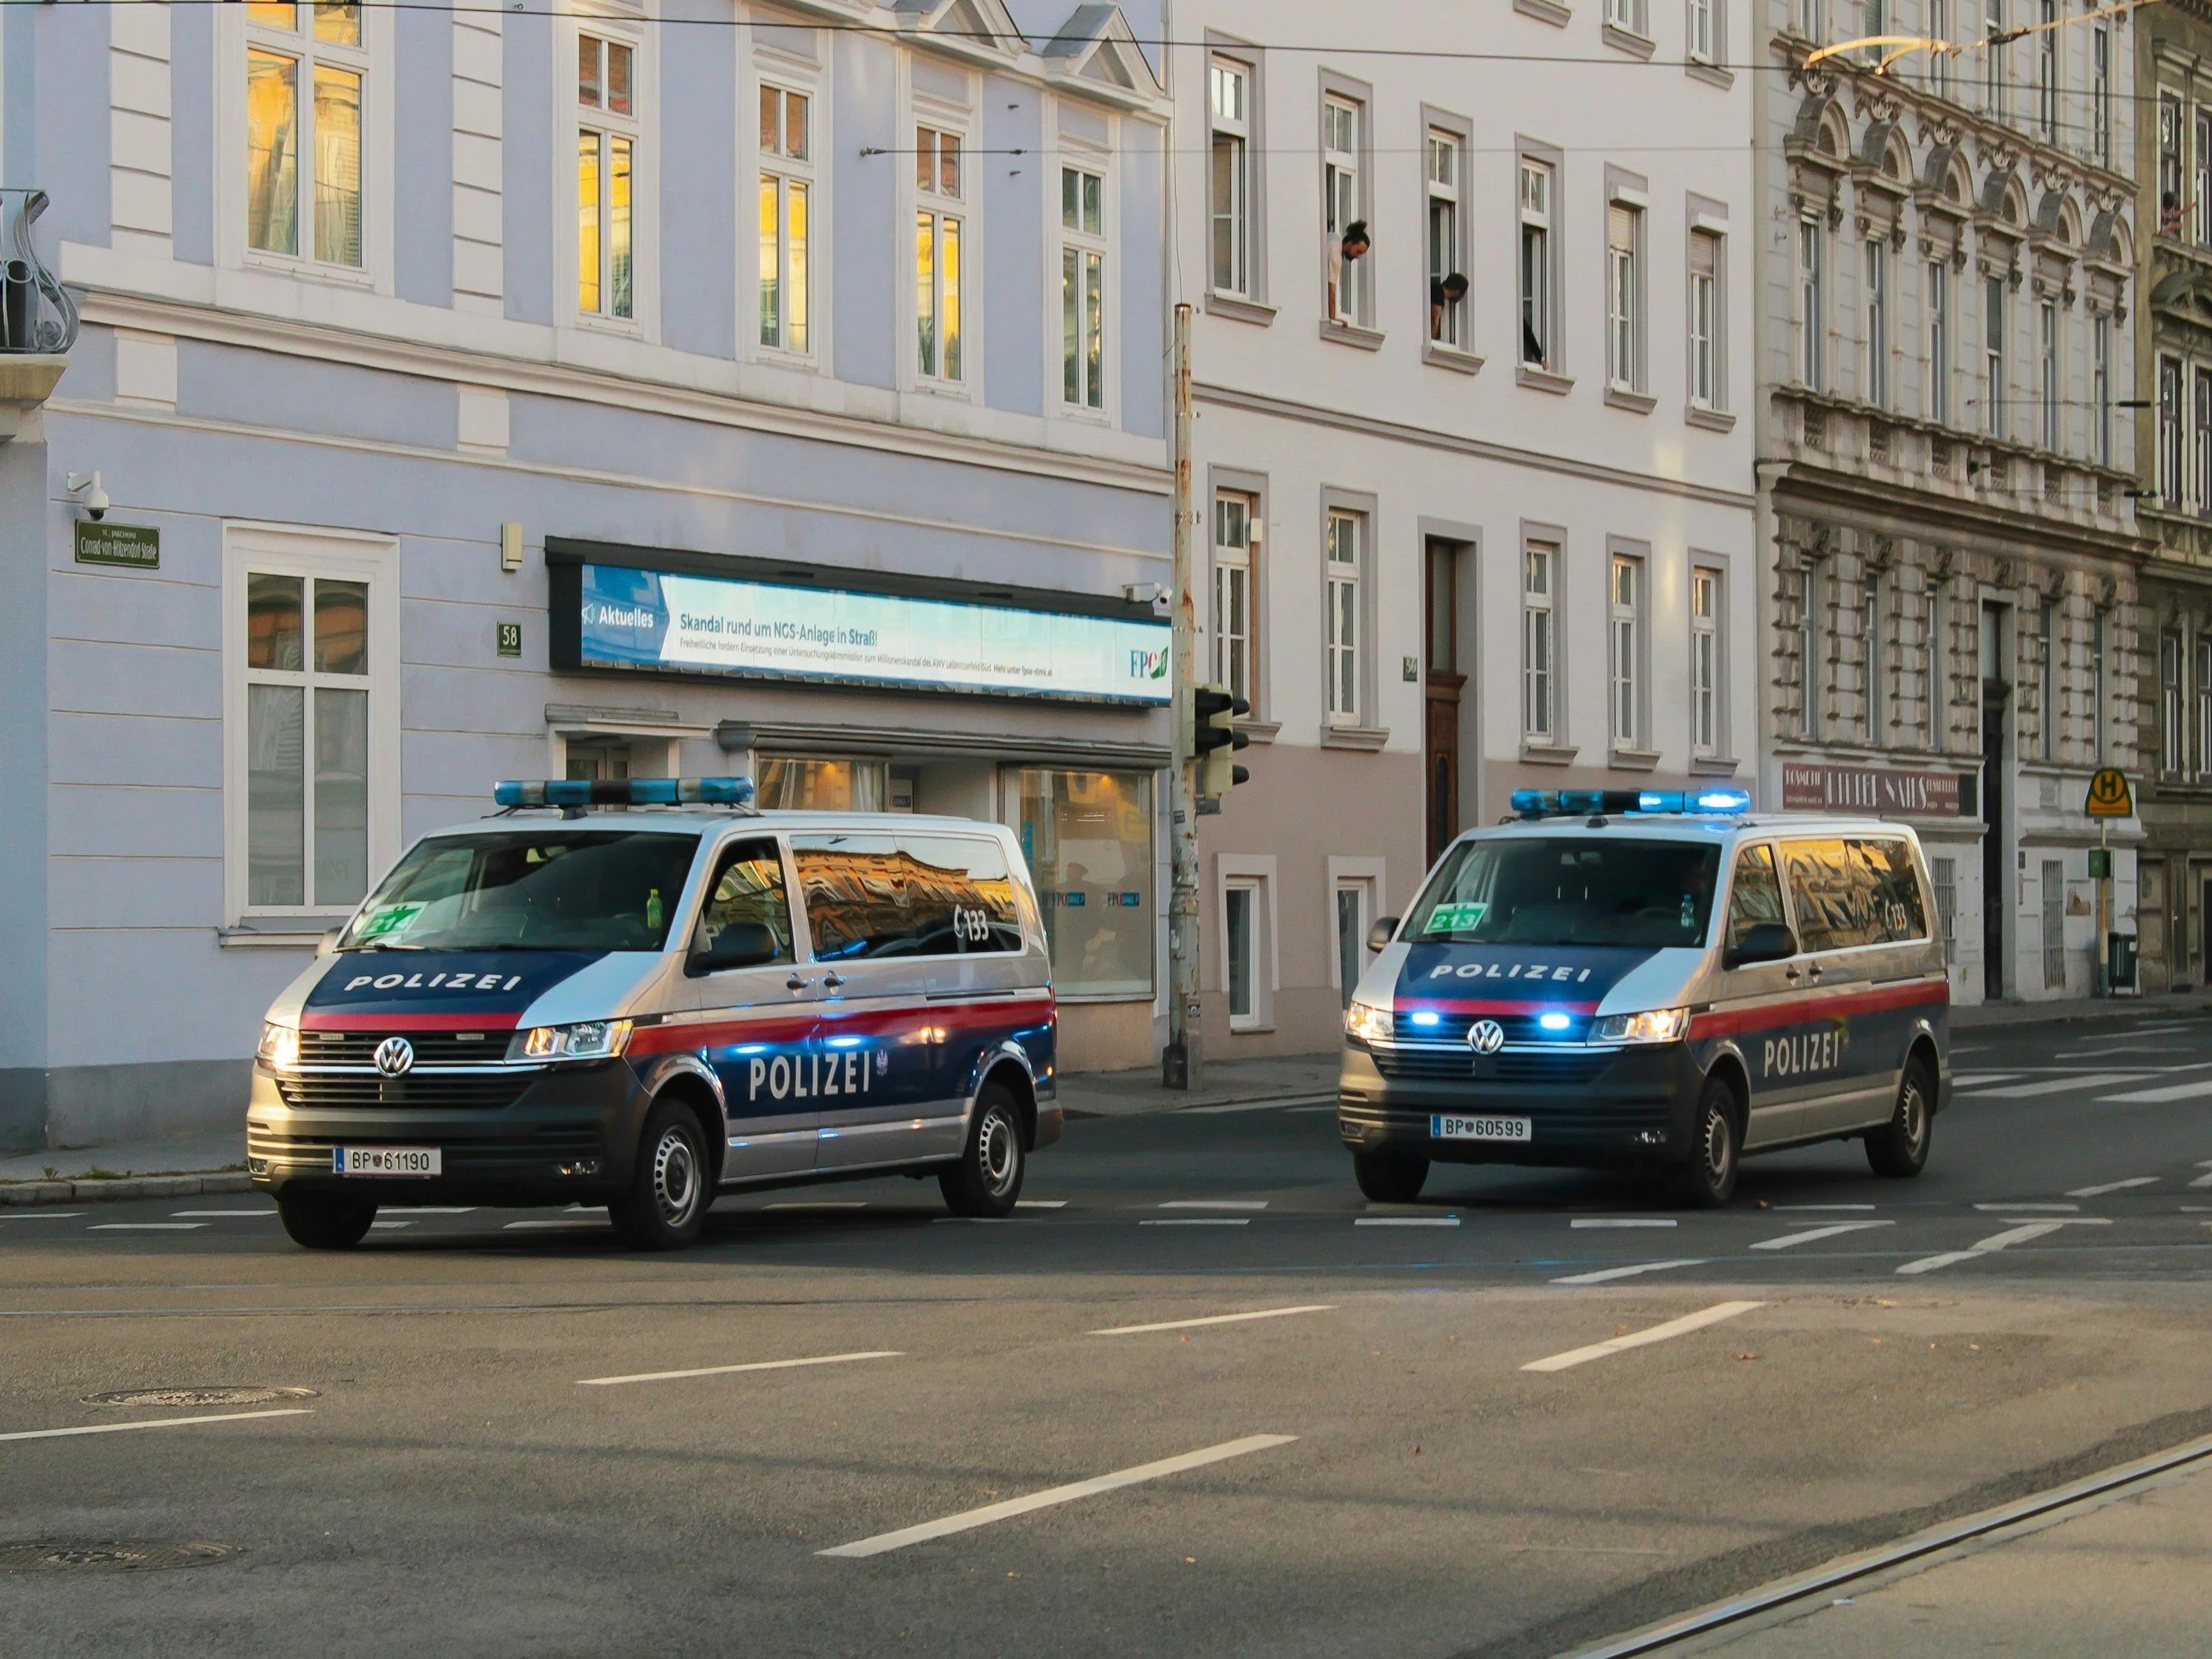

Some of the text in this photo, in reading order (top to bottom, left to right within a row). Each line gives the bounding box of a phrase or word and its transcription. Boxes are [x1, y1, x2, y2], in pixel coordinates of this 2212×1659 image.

[598, 605, 653, 629] Aktuelles
[503, 625, 517, 646] 58
[680, 613, 877, 647] Skandal rund um NGS-Anlage in Straß!
[680, 636, 715, 651] Freiheitliche
[2101, 773, 2117, 797] H
[963, 909, 989, 941] 133
[1430, 914, 1476, 929] 213
[1890, 902, 1907, 932] 133
[344, 972, 522, 991] POLIZEI
[1429, 964, 1591, 983] POLIZEI
[1764, 1031, 1839, 1078] POLIZEI
[750, 1051, 869, 1101] POLIZEI
[1445, 1118, 1463, 1135] BP
[1476, 1120, 1524, 1137] 60599
[352, 1151, 371, 1170] BP
[384, 1152, 430, 1171] 61190
